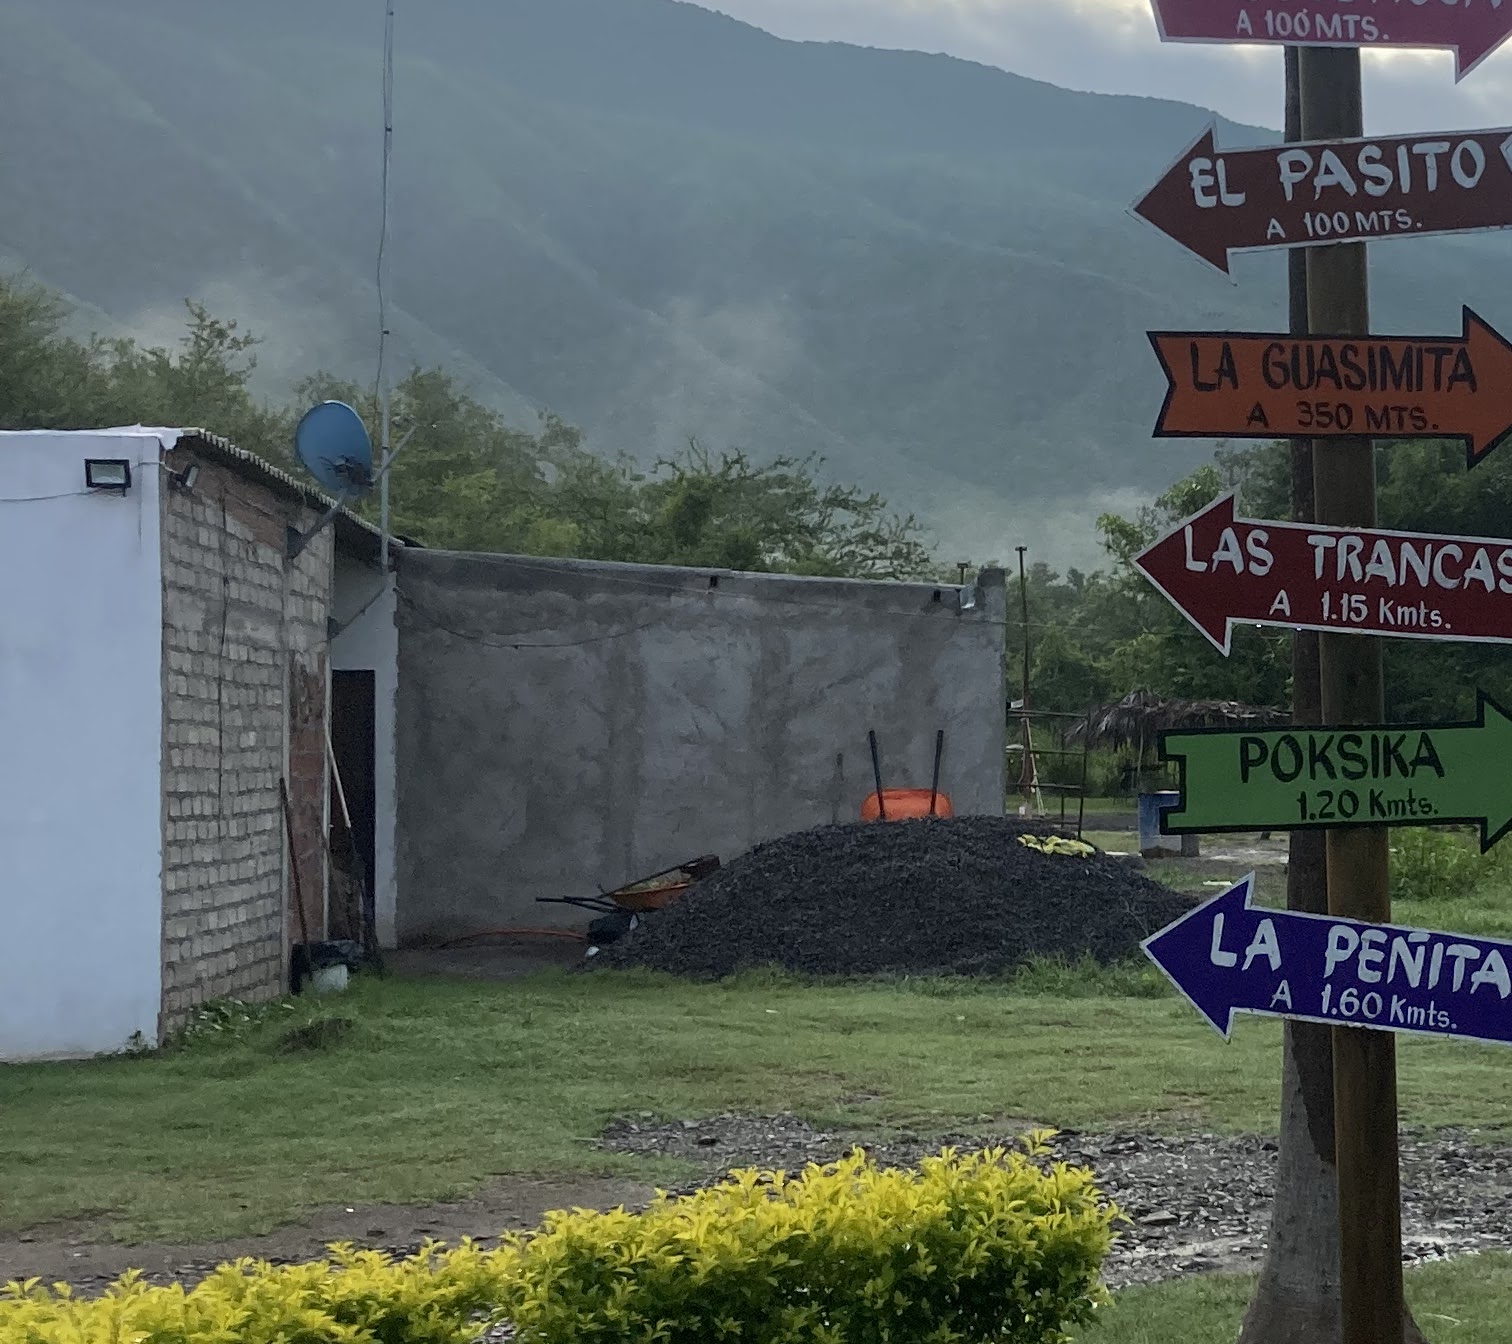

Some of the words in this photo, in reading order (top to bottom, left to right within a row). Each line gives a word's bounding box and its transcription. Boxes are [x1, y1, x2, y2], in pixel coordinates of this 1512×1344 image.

[1237, 13, 1253, 35] A
[1265, 9, 1311, 38] 100
[1316, 13, 1389, 41] MTS.
[1189, 157, 1246, 208] EL
[1277, 139, 1486, 202] PASITO
[1266, 217, 1285, 240] A
[1304, 212, 1350, 236] 100
[1356, 209, 1423, 232] MTS.
[1190, 341, 1239, 392] LA
[1262, 341, 1477, 393] GUASIMITA
[1247, 401, 1268, 428] A
[1298, 402, 1353, 430] 350
[1365, 405, 1439, 432] MTS.
[1184, 525, 1274, 576] LAS
[1269, 590, 1291, 617] A
[1321, 591, 1368, 622] 1.15
[1380, 598, 1452, 629] Kmts.
[1240, 733, 1445, 783] POKSIKA
[1296, 792, 1359, 820] 1.20
[1370, 789, 1439, 818] Kmts.
[1210, 913, 1282, 971] LA
[1323, 924, 1512, 999] PEÑITA
[1270, 980, 1292, 1009] A
[1321, 984, 1382, 1018] 1.60
[1390, 1000, 1457, 1030] Kmts.
